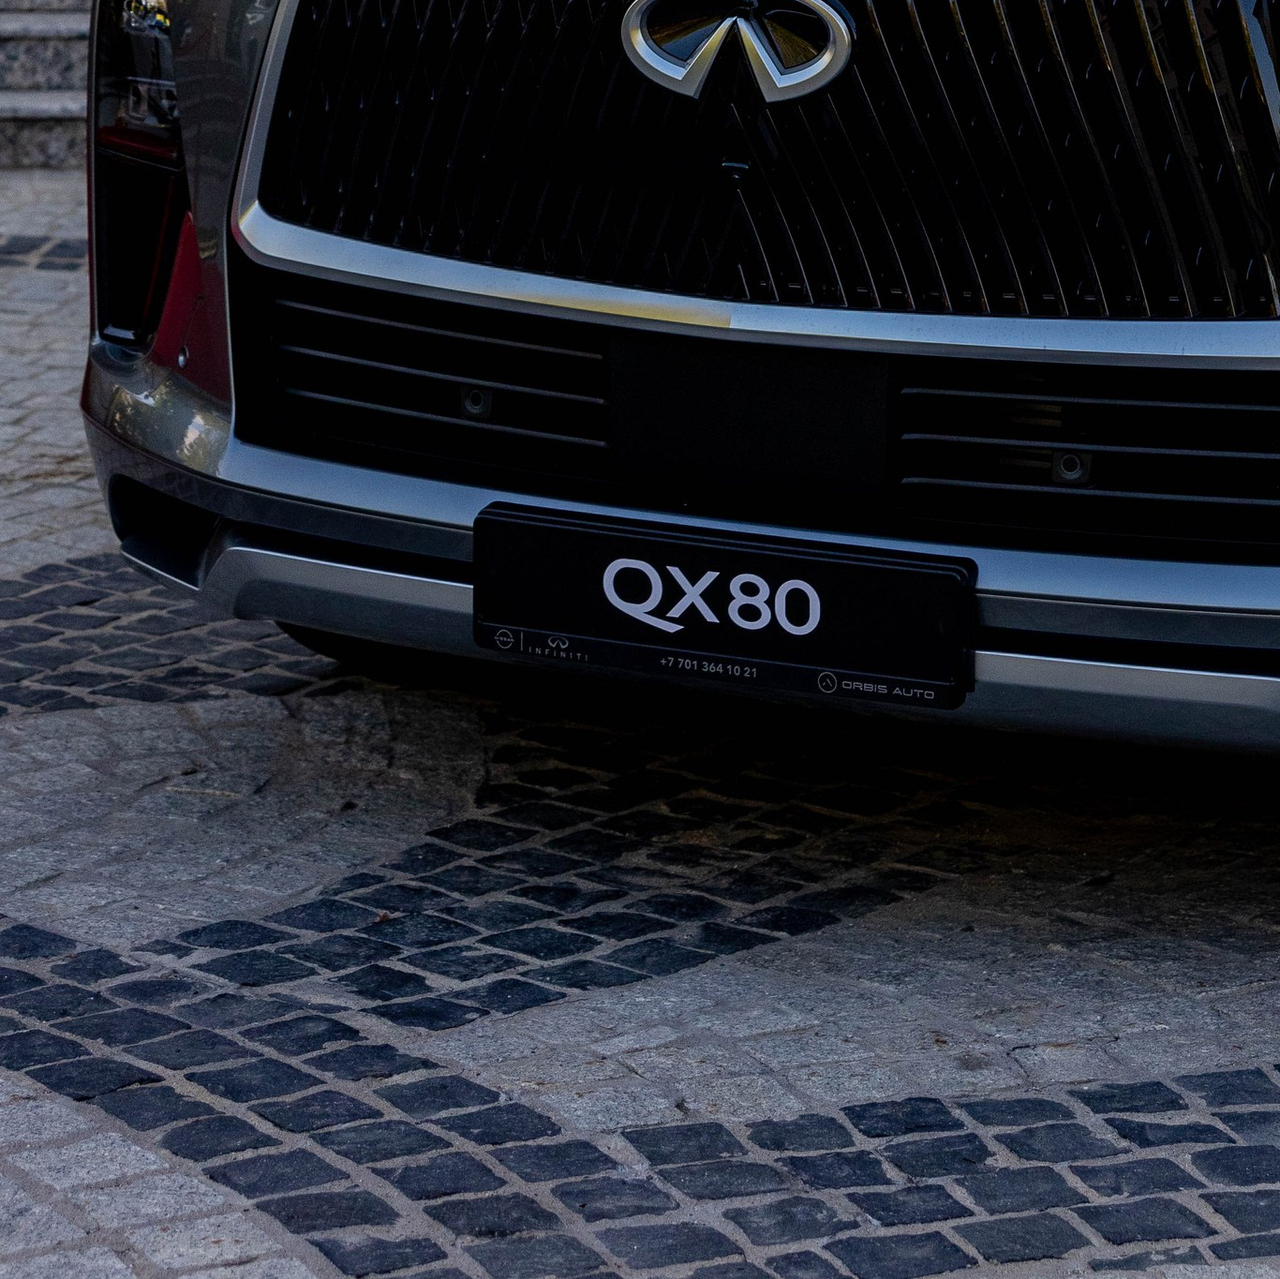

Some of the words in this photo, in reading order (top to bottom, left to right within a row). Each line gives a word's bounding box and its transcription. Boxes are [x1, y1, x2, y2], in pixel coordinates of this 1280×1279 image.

[602, 558, 821, 636] QX80
[528, 646, 589, 661] INFINITI
[660, 657, 675, 668] +7
[677, 659, 698, 670] 701
[702, 661, 724, 673] 364
[726, 665, 741, 675] 10
[743, 667, 757, 678] 21
[842, 681, 888, 694] ORBIS
[893, 686, 935, 699] AUTO
